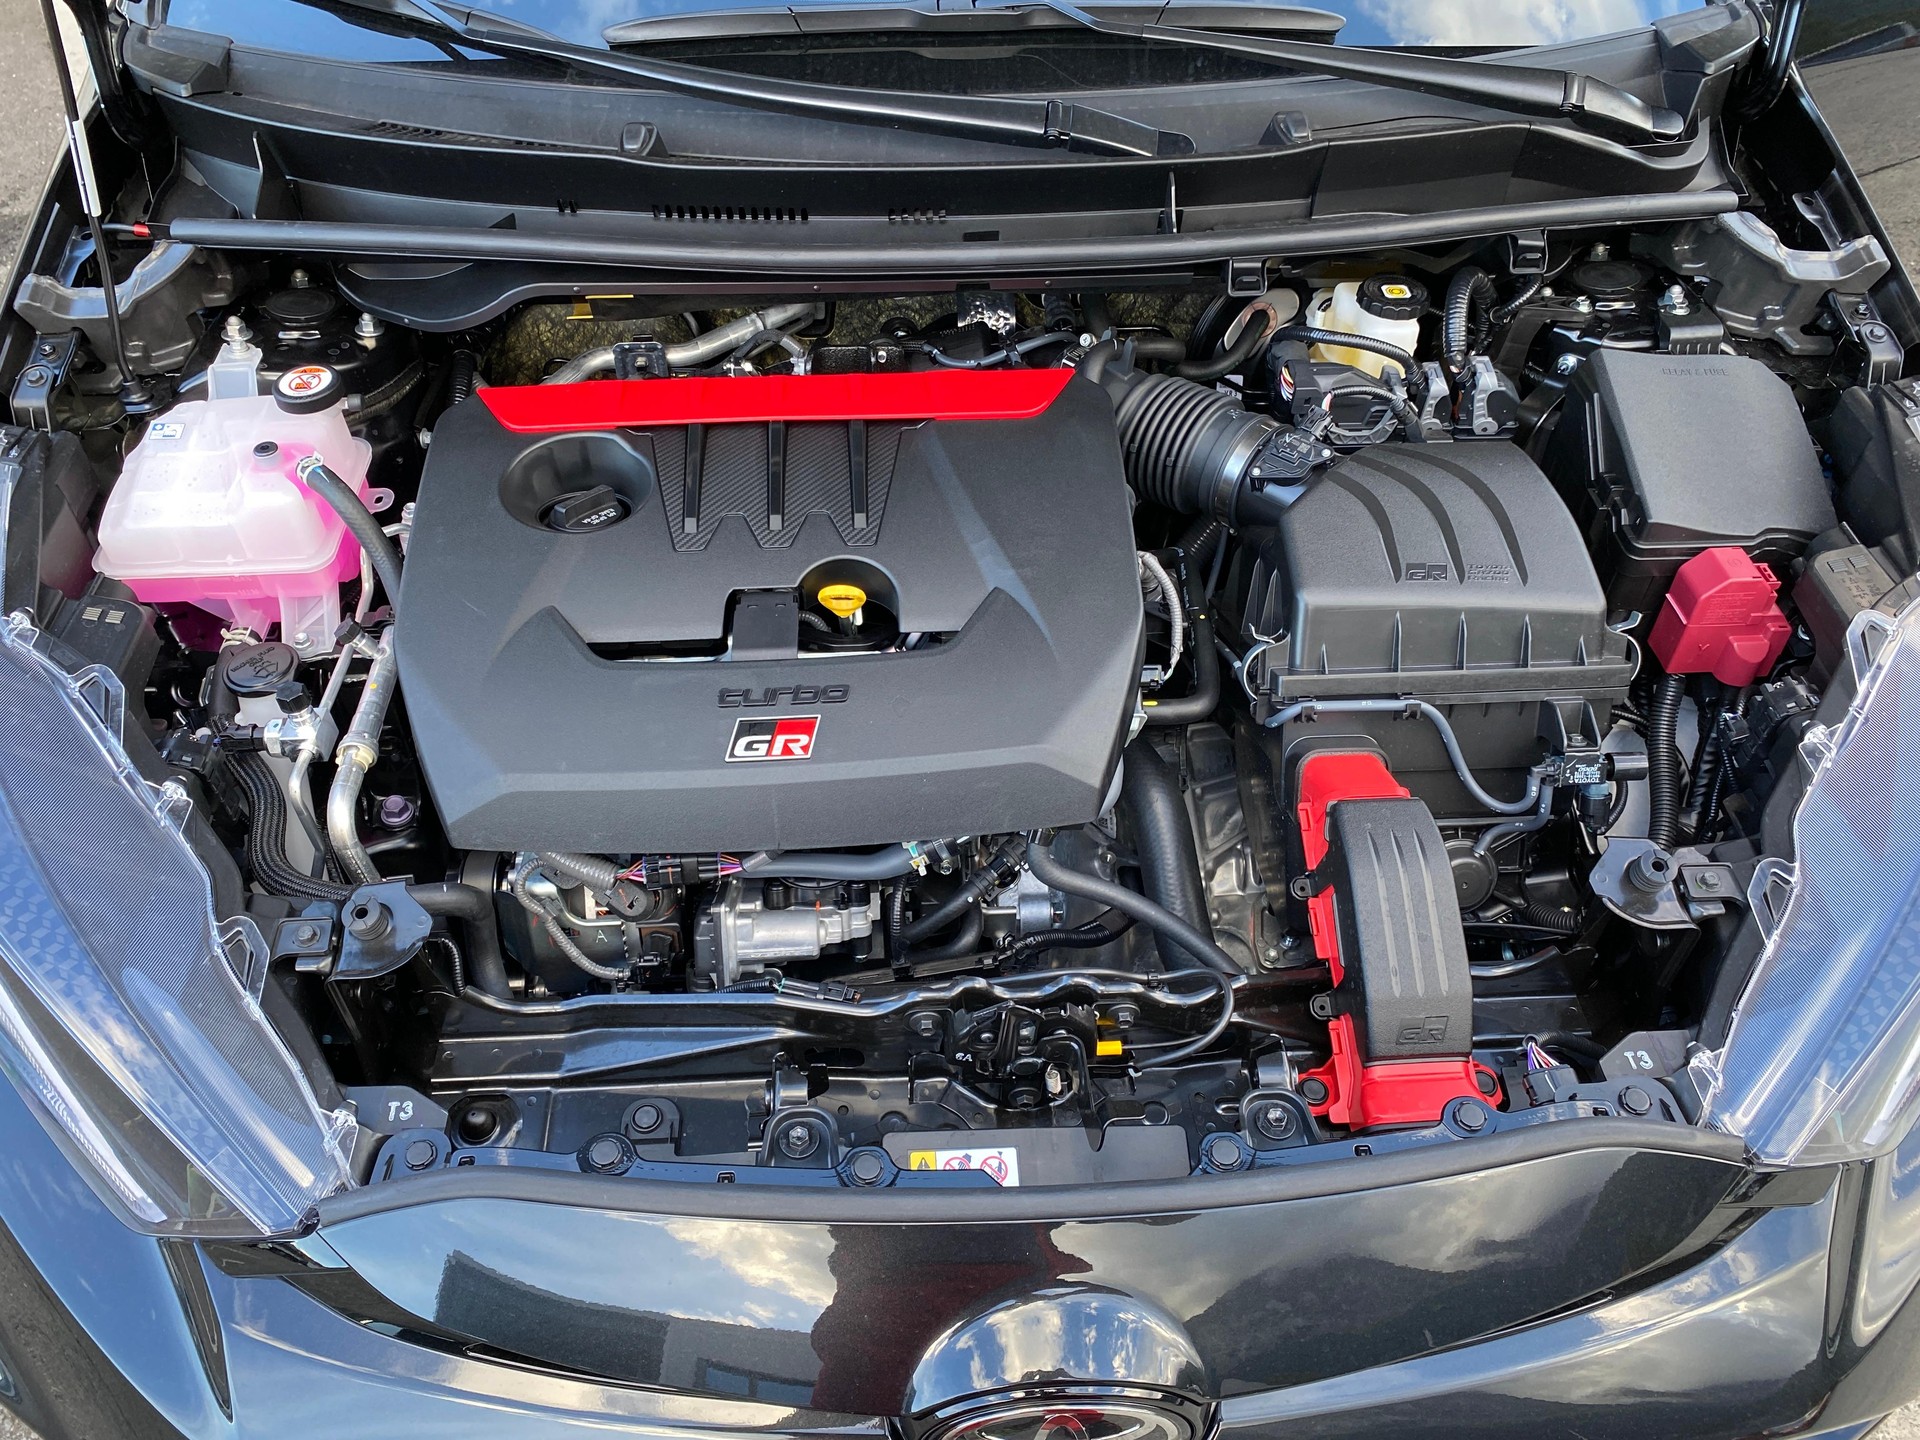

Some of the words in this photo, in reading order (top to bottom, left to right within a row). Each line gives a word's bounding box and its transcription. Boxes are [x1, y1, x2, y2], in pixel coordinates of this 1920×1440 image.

[717, 684, 850, 708] turbo
[733, 734, 811, 757] GR
[1623, 1050, 1654, 1070] T3
[388, 1100, 414, 1122] T3
